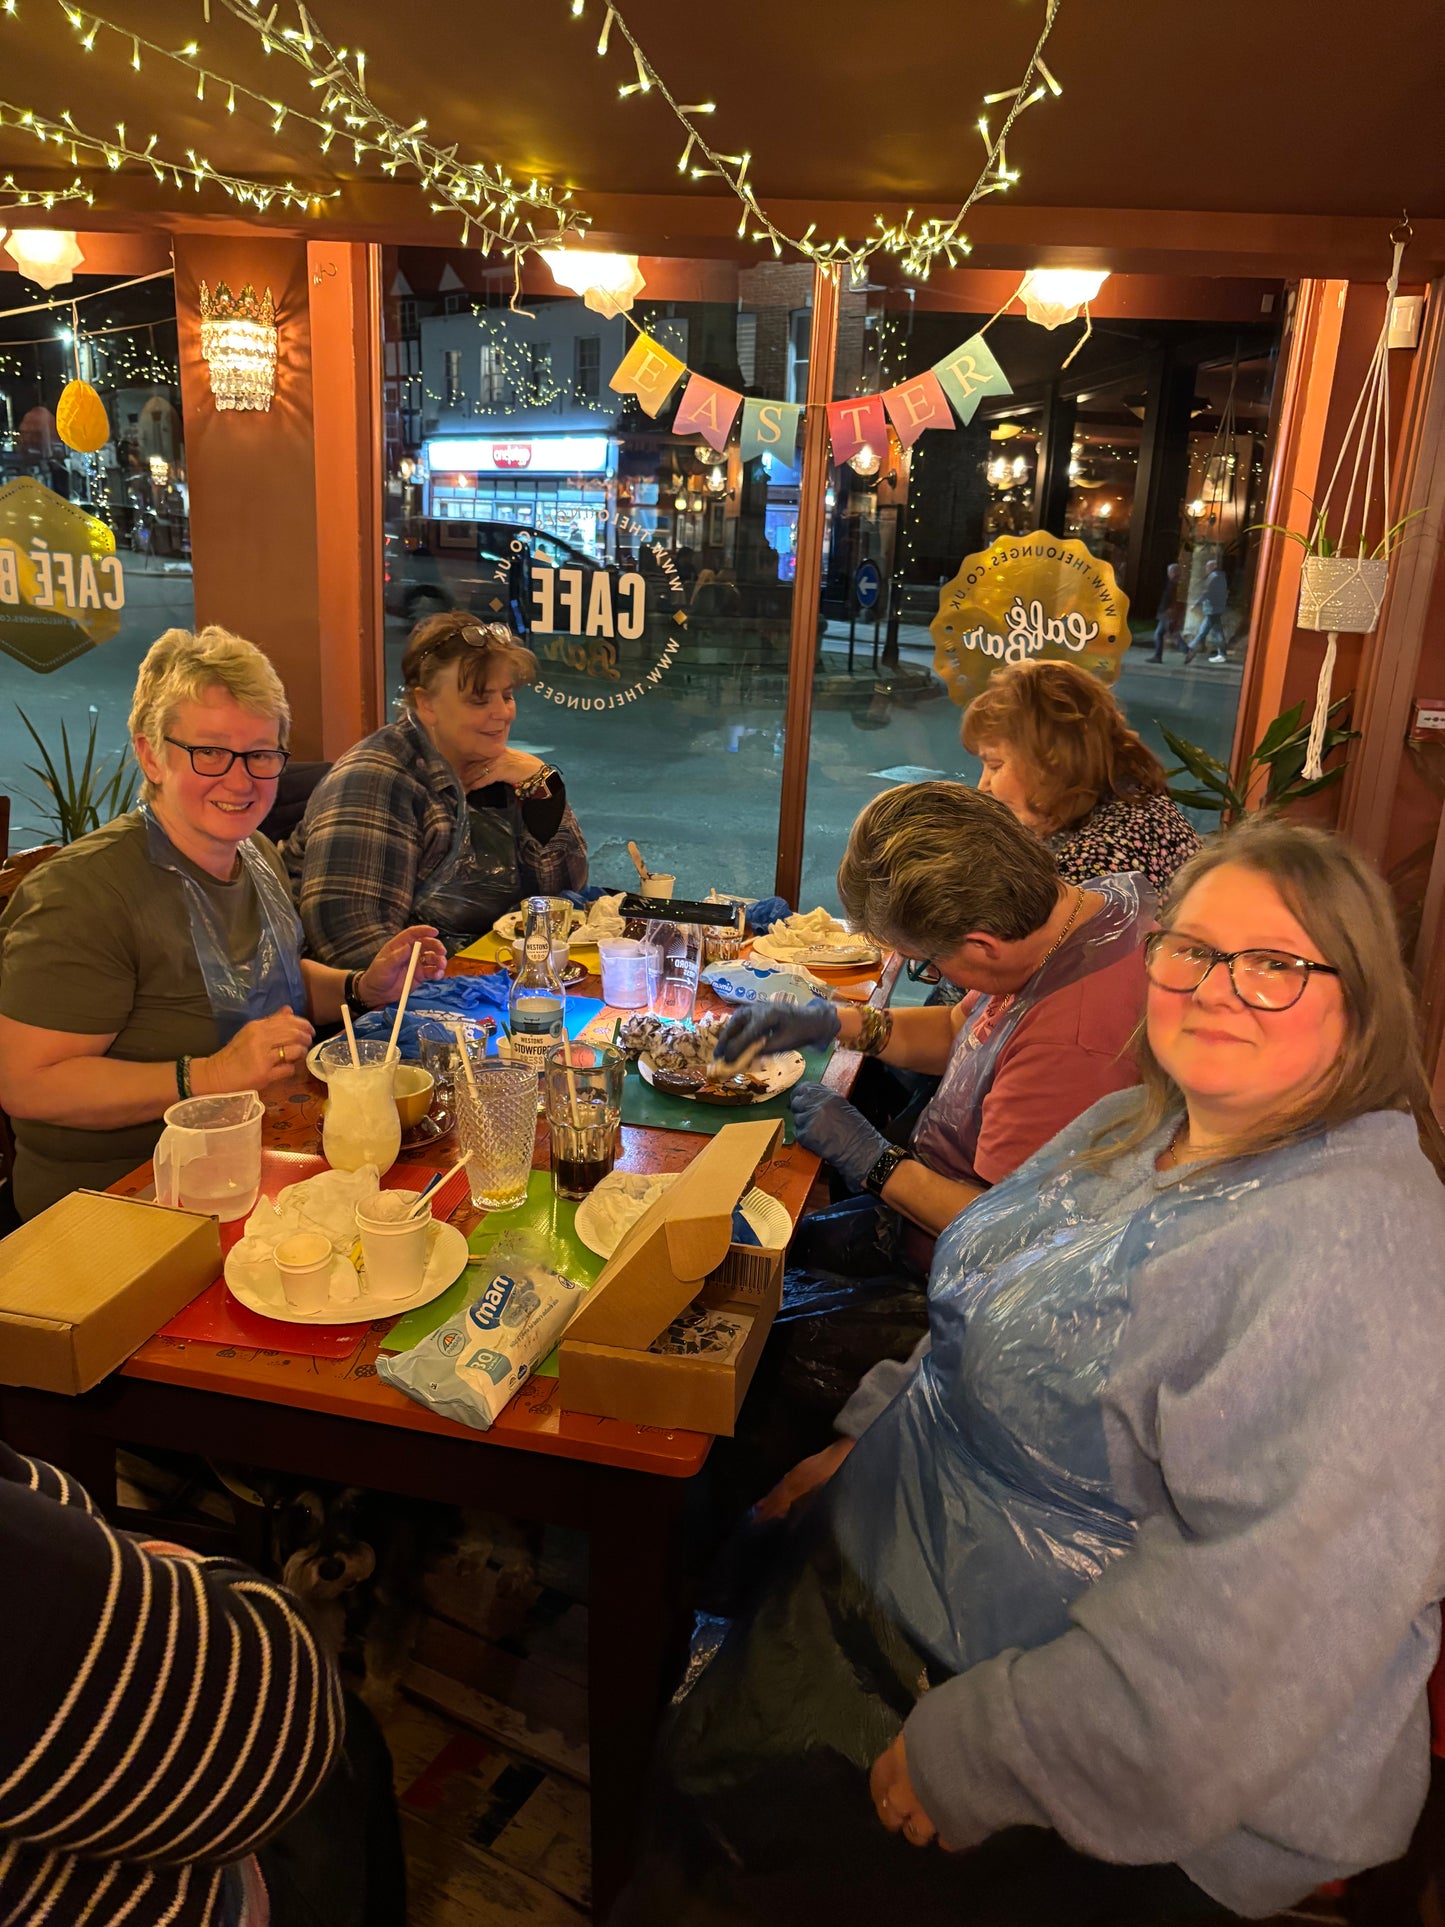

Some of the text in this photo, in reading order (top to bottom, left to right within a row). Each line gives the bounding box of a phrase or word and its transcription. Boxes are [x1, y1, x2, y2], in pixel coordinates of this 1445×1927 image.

[629, 348, 994, 446] EASTER
[520, 1036, 544, 1045] WESTONS
[513, 1042, 551, 1056] STOWFOR
